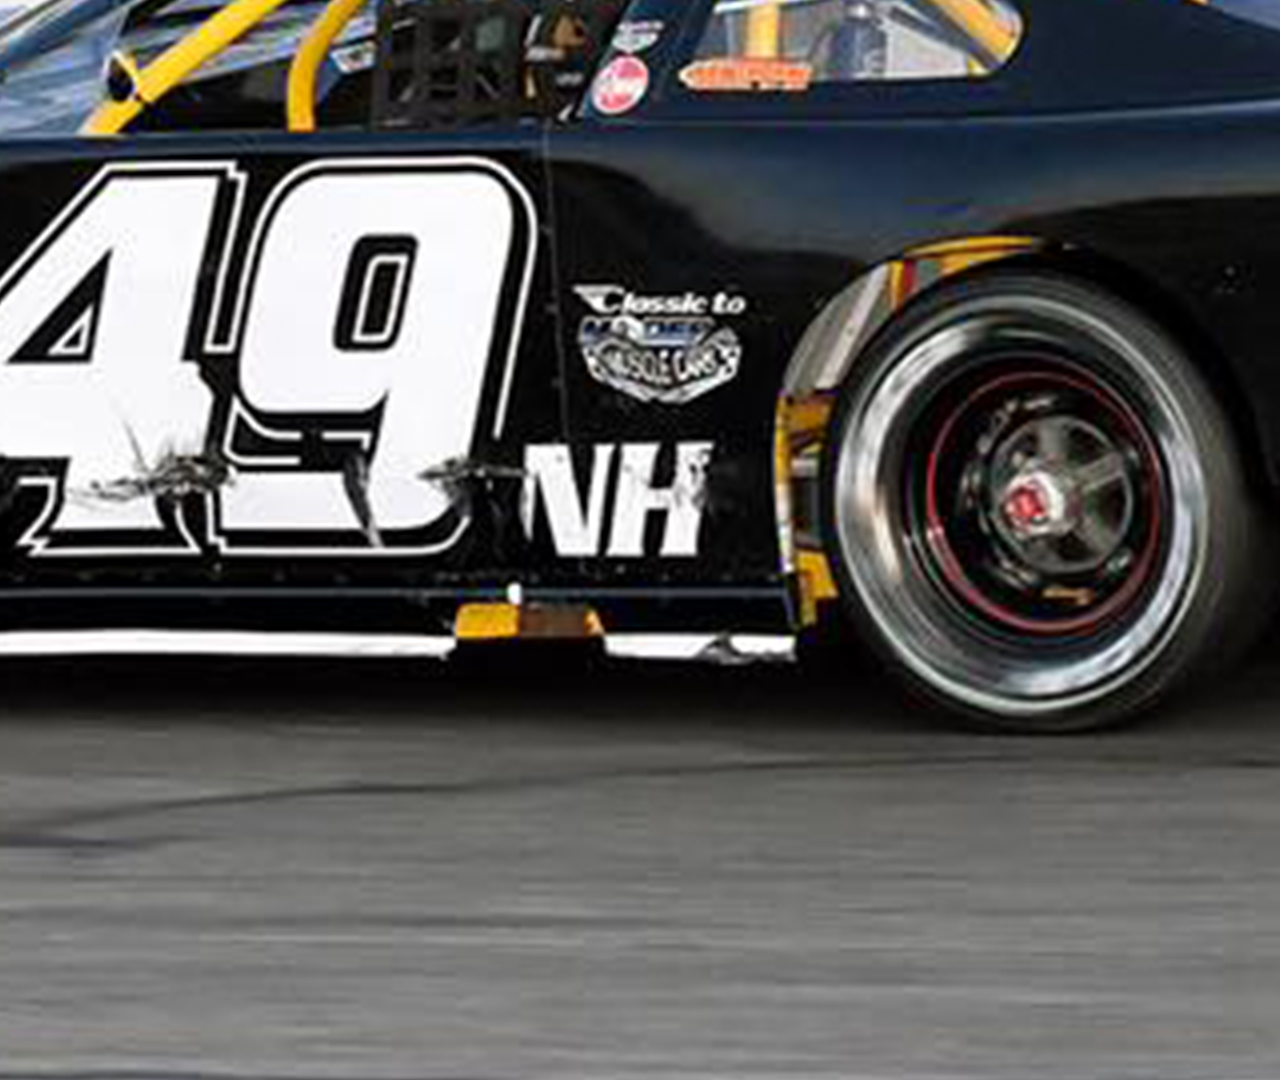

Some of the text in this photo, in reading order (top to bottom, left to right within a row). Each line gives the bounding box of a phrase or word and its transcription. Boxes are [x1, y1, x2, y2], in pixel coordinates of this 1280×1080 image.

[572, 284, 747, 315] Classic to
[519, 442, 715, 557] NH
